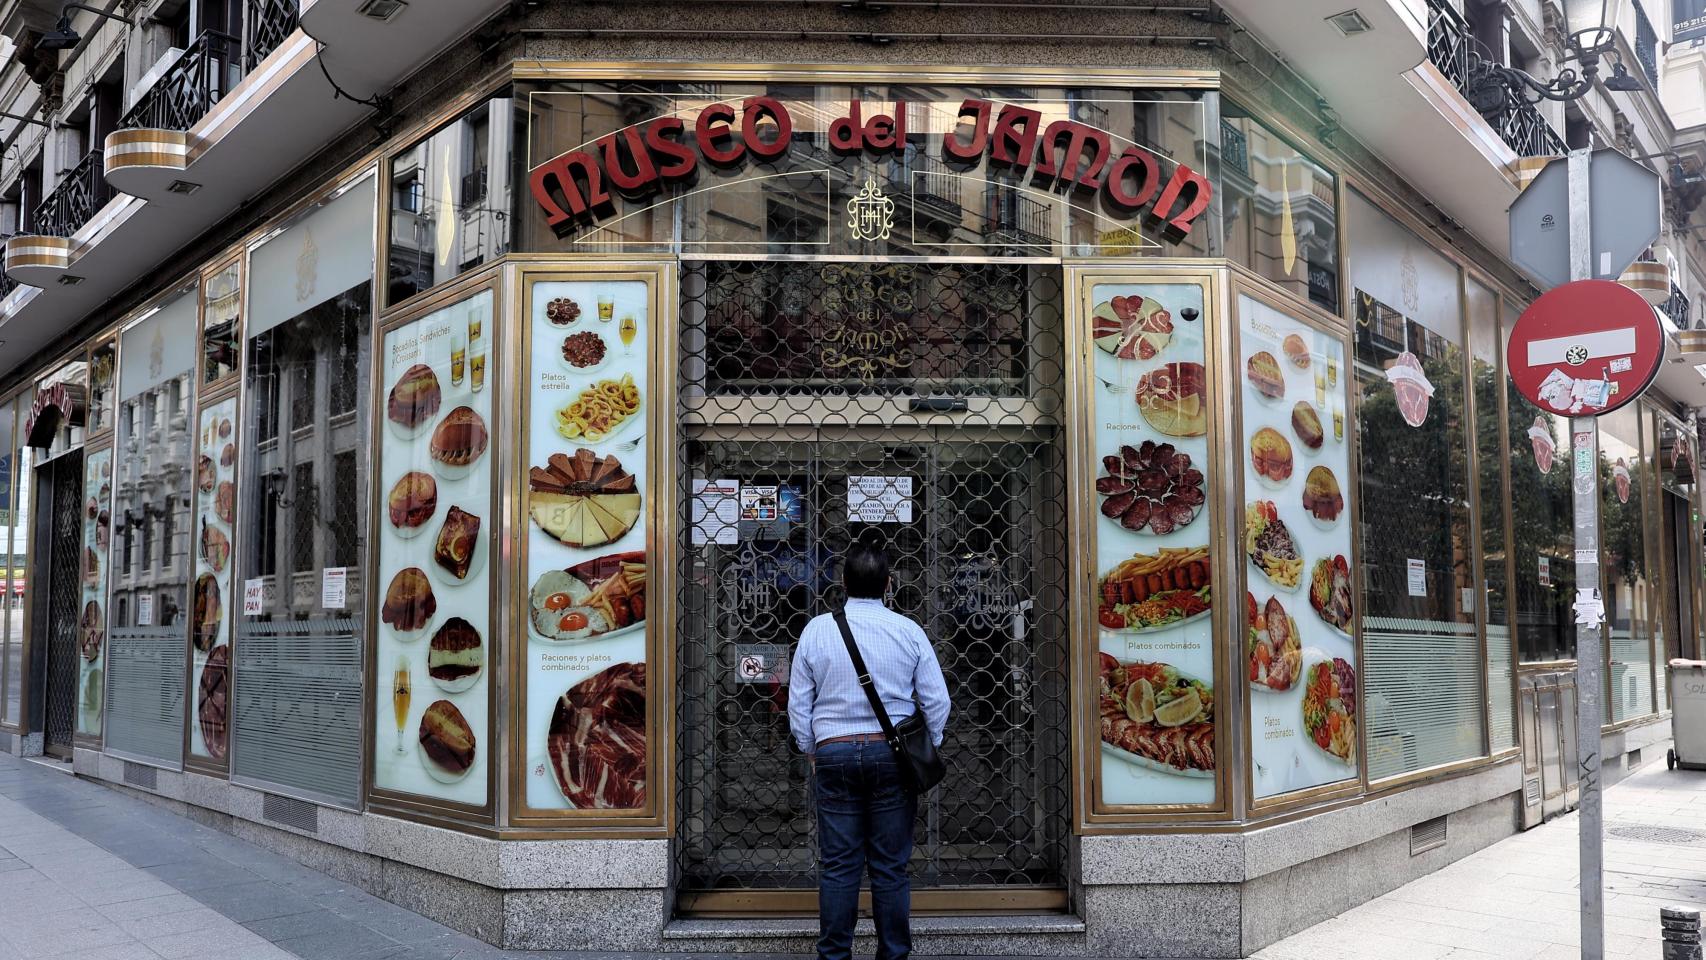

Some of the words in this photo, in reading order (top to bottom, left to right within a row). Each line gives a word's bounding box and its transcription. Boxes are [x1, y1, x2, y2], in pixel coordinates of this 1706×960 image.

[1673, 21, 1690, 30] 915
[529, 95, 793, 230] MUSEO
[828, 99, 906, 154] del
[943, 98, 1213, 236] JAMON
[541, 373, 567, 381] Platos
[541, 382, 570, 390] estrella
[1106, 423, 1141, 431] Raciones
[247, 588, 261, 598] HAY
[246, 601, 260, 611] PAN
[1128, 642, 1152, 650] Platos
[1154, 641, 1200, 650] combinados
[541, 653, 578, 661] Raciones
[579, 655, 585, 663] y
[586, 654, 612, 663] platos
